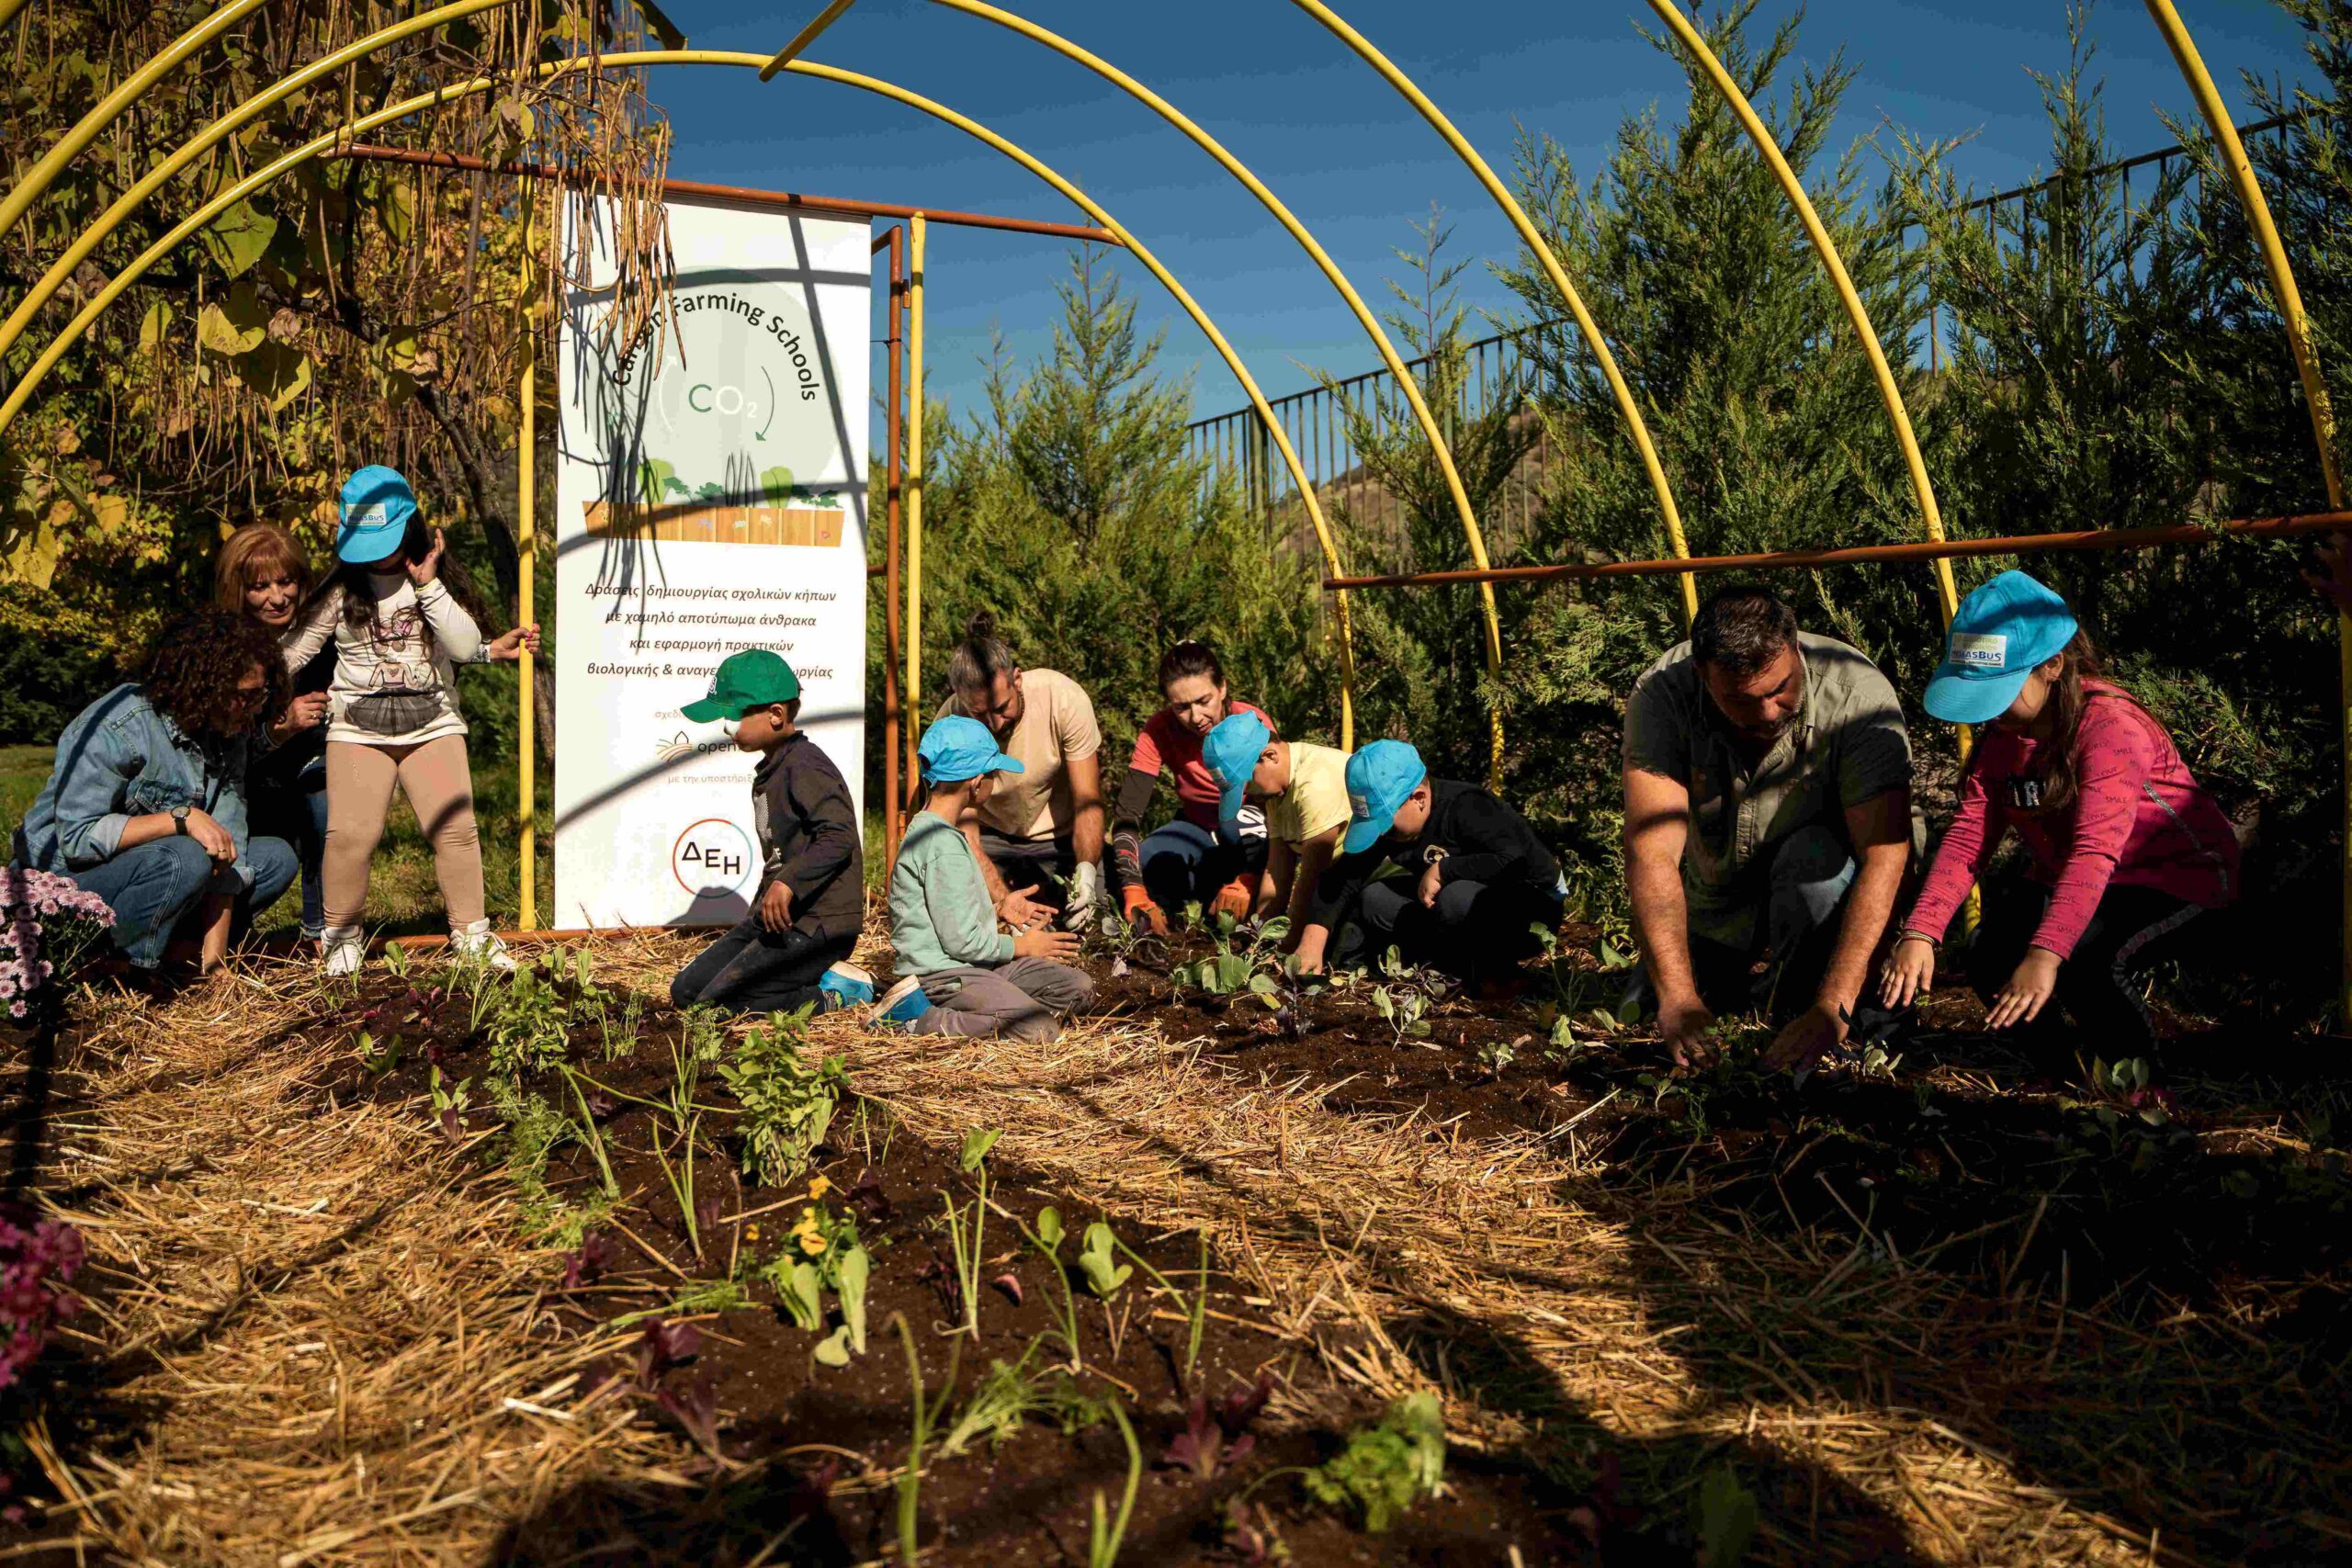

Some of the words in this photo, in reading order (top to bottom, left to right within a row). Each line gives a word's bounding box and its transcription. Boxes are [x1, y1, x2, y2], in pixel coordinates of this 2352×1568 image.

[612, 310, 668, 387] Caon
[668, 292, 765, 327] Farming
[765, 315, 820, 401] Schools
[646, 584, 729, 600] δημιουργίας
[731, 588, 792, 602] σχολικών
[795, 589, 837, 604] κήπων
[605, 613, 622, 624] με
[625, 611, 675, 625] χαμηλό
[678, 612, 756, 627] αποτύπωμα
[759, 614, 817, 628] άνθρακα
[629, 640, 650, 649] και
[654, 638, 722, 652] εφαρμογή
[725, 639, 795, 653] πρακτικών
[588, 662, 660, 678] βιολογικής
[662, 663, 673, 675] &
[682, 840, 741, 875] ΔΕΗ
